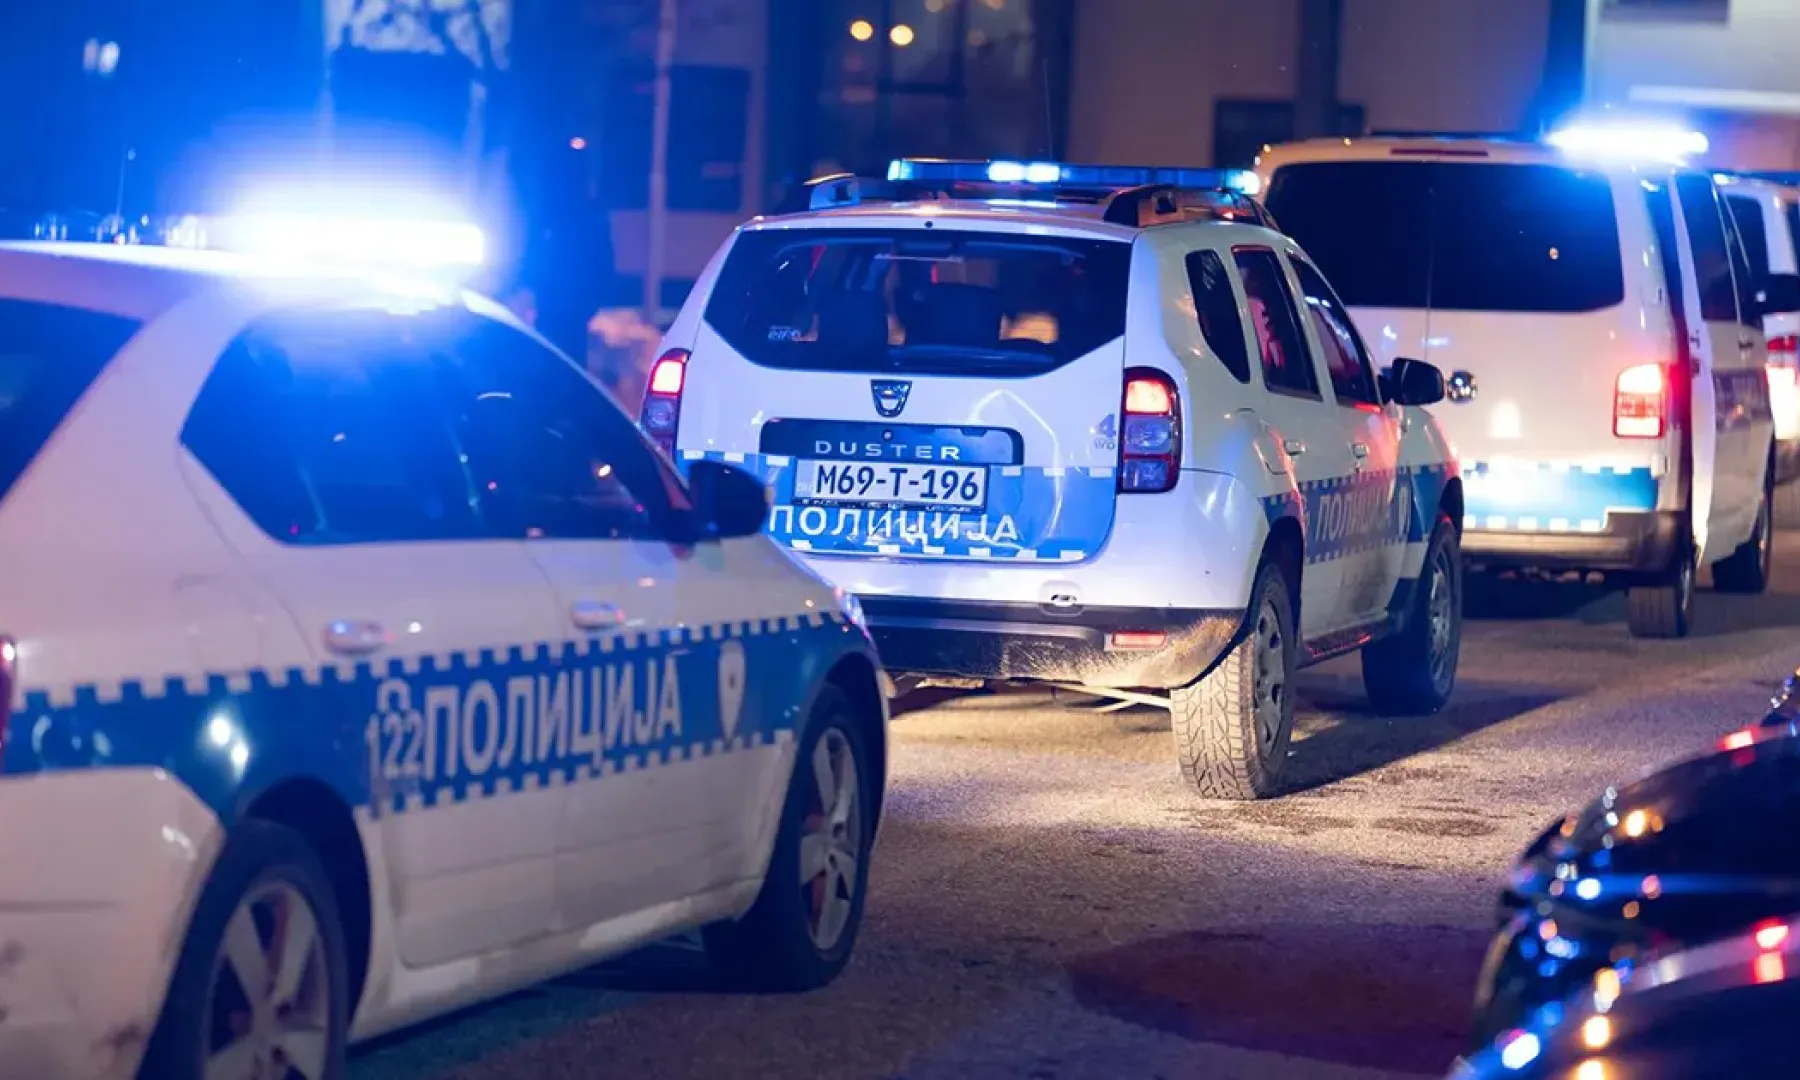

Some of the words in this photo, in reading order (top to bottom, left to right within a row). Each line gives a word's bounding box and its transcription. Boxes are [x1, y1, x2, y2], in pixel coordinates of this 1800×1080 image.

[815, 440, 961, 460] DUSTER
[816, 465, 978, 500] M69-T-196
[769, 505, 1018, 544] ПОЛИЦИЈА
[424, 656, 681, 780] ПОЛИЦИЈА
[365, 709, 424, 778] 122
